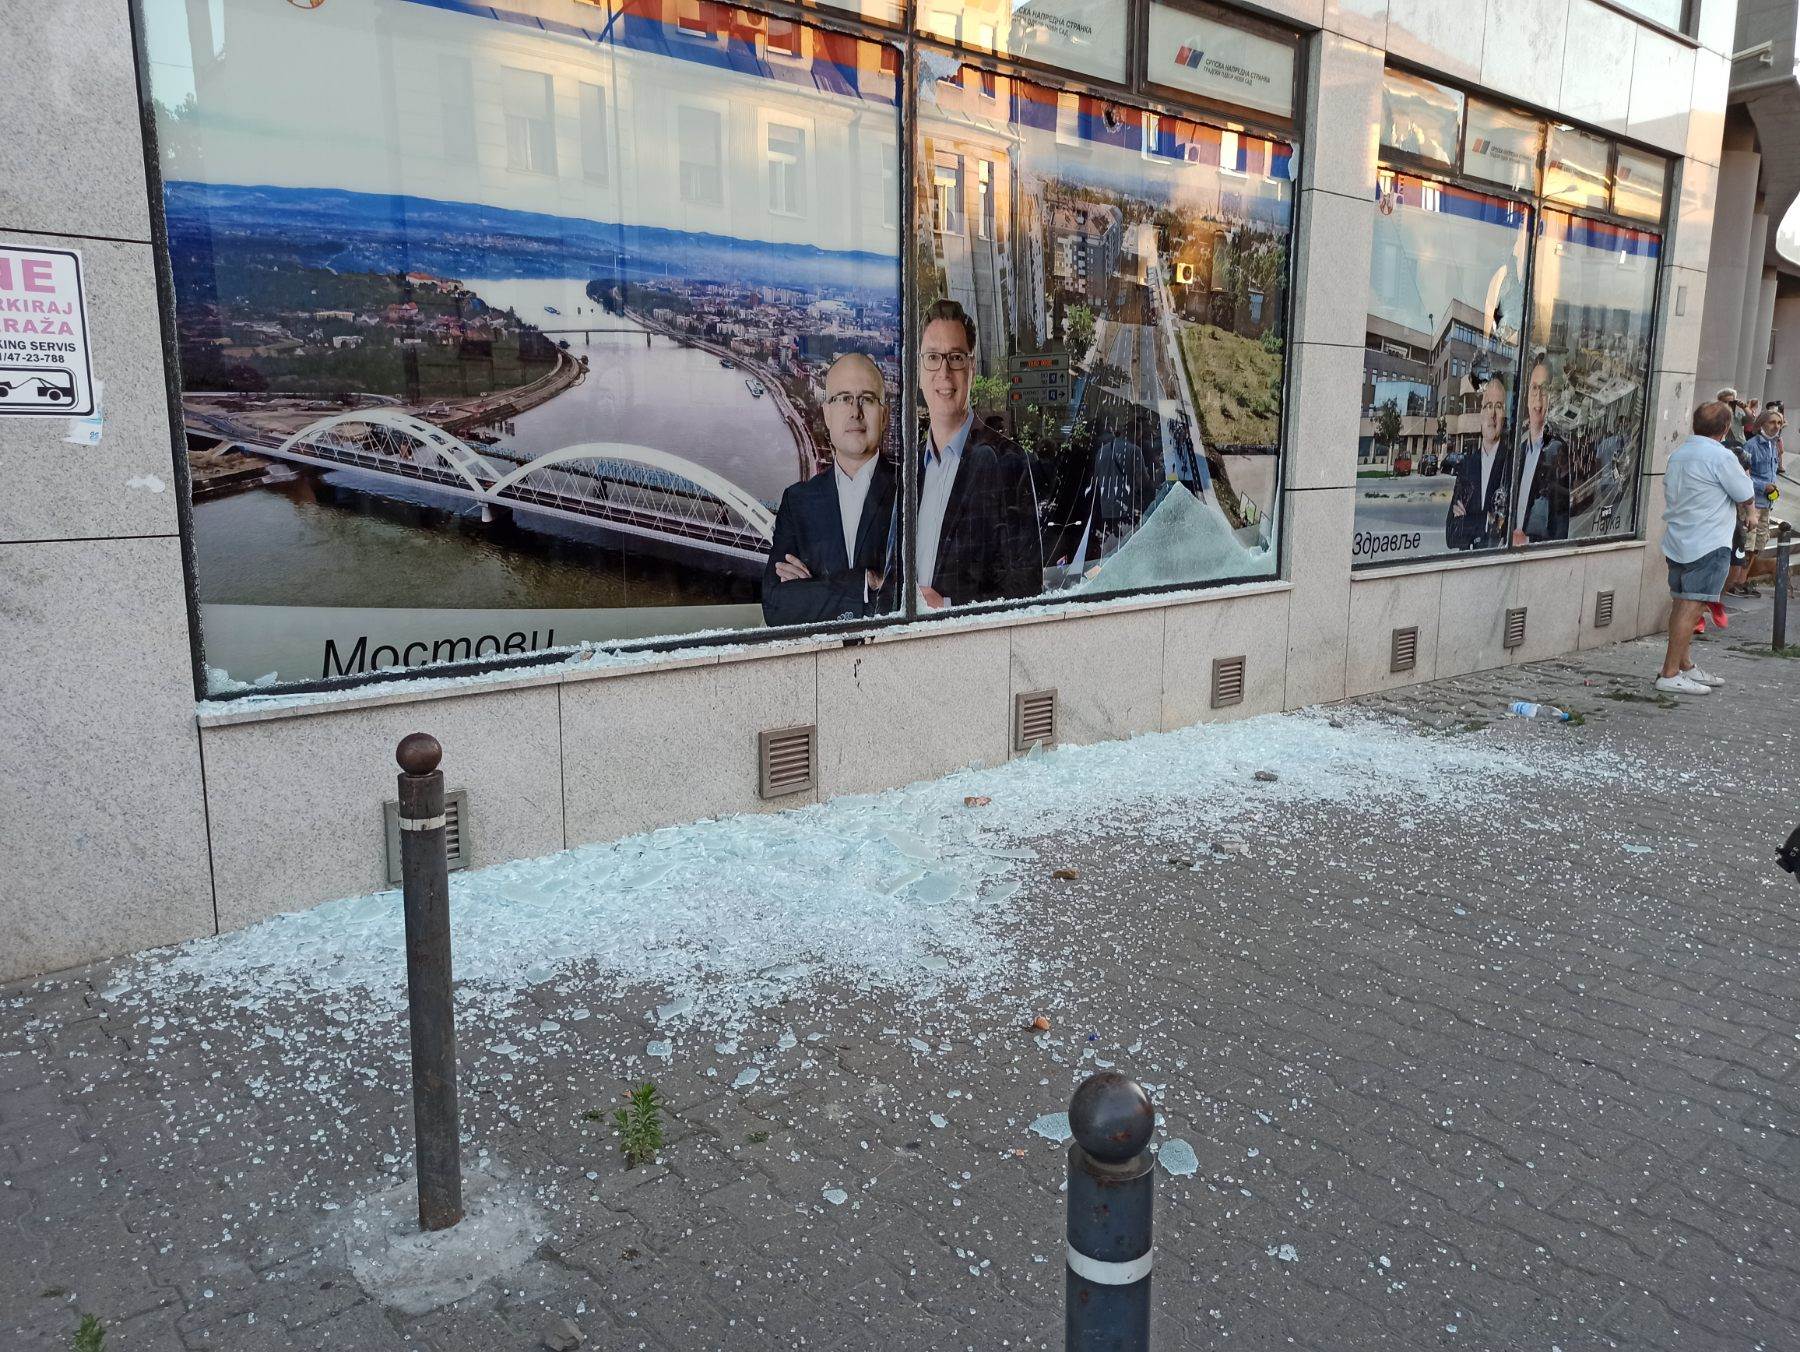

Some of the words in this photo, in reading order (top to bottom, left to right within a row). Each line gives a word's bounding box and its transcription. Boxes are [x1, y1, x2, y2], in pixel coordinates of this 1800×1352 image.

[1066, 20, 1092, 35] СТРАНКА
[30, 341, 76, 352] SERVIS
[1352, 531, 1421, 559] Здравље
